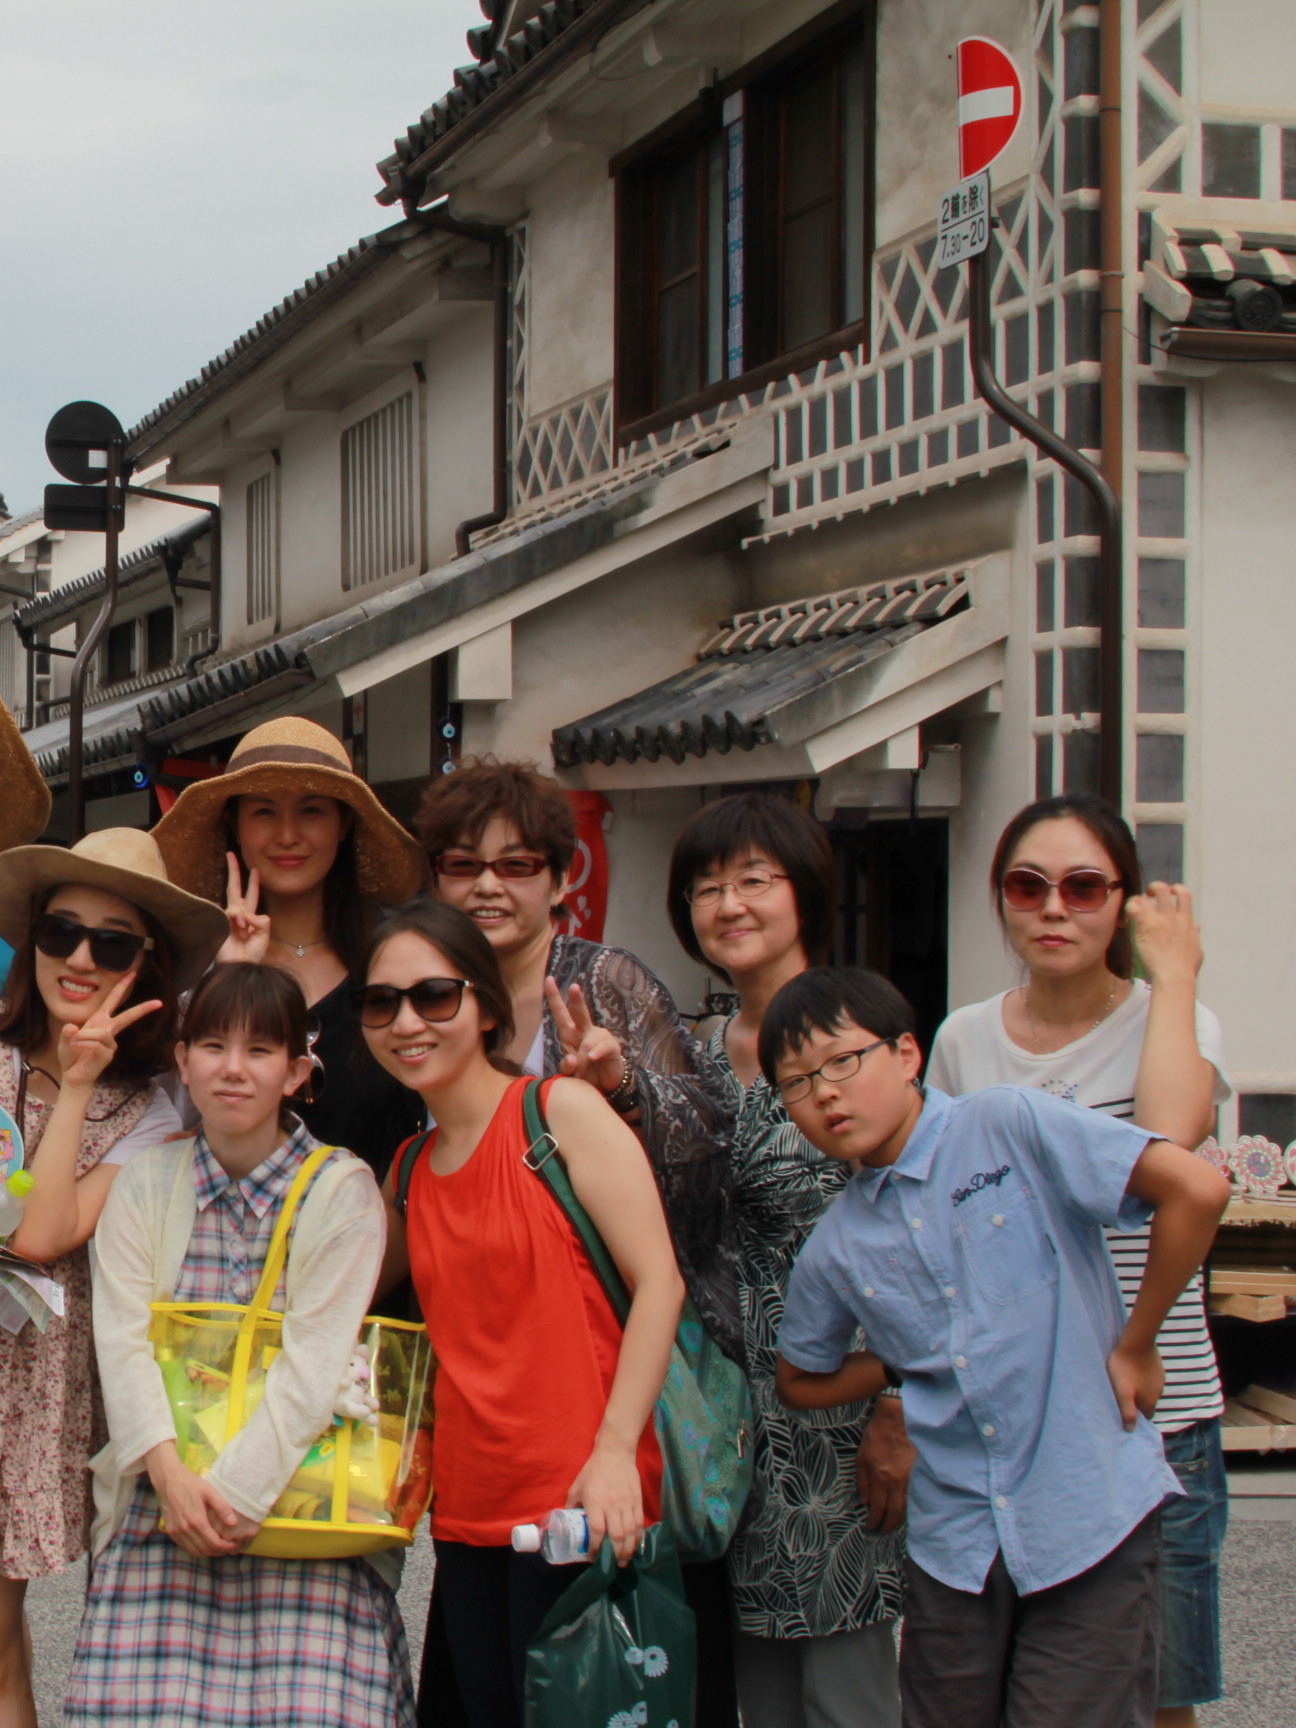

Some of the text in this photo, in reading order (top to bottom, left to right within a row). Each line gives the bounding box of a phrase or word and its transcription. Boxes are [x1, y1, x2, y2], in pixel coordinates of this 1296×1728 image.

[941, 184, 984, 225] 2輪を除く
[970, 1165, 1010, 1190] Diego
